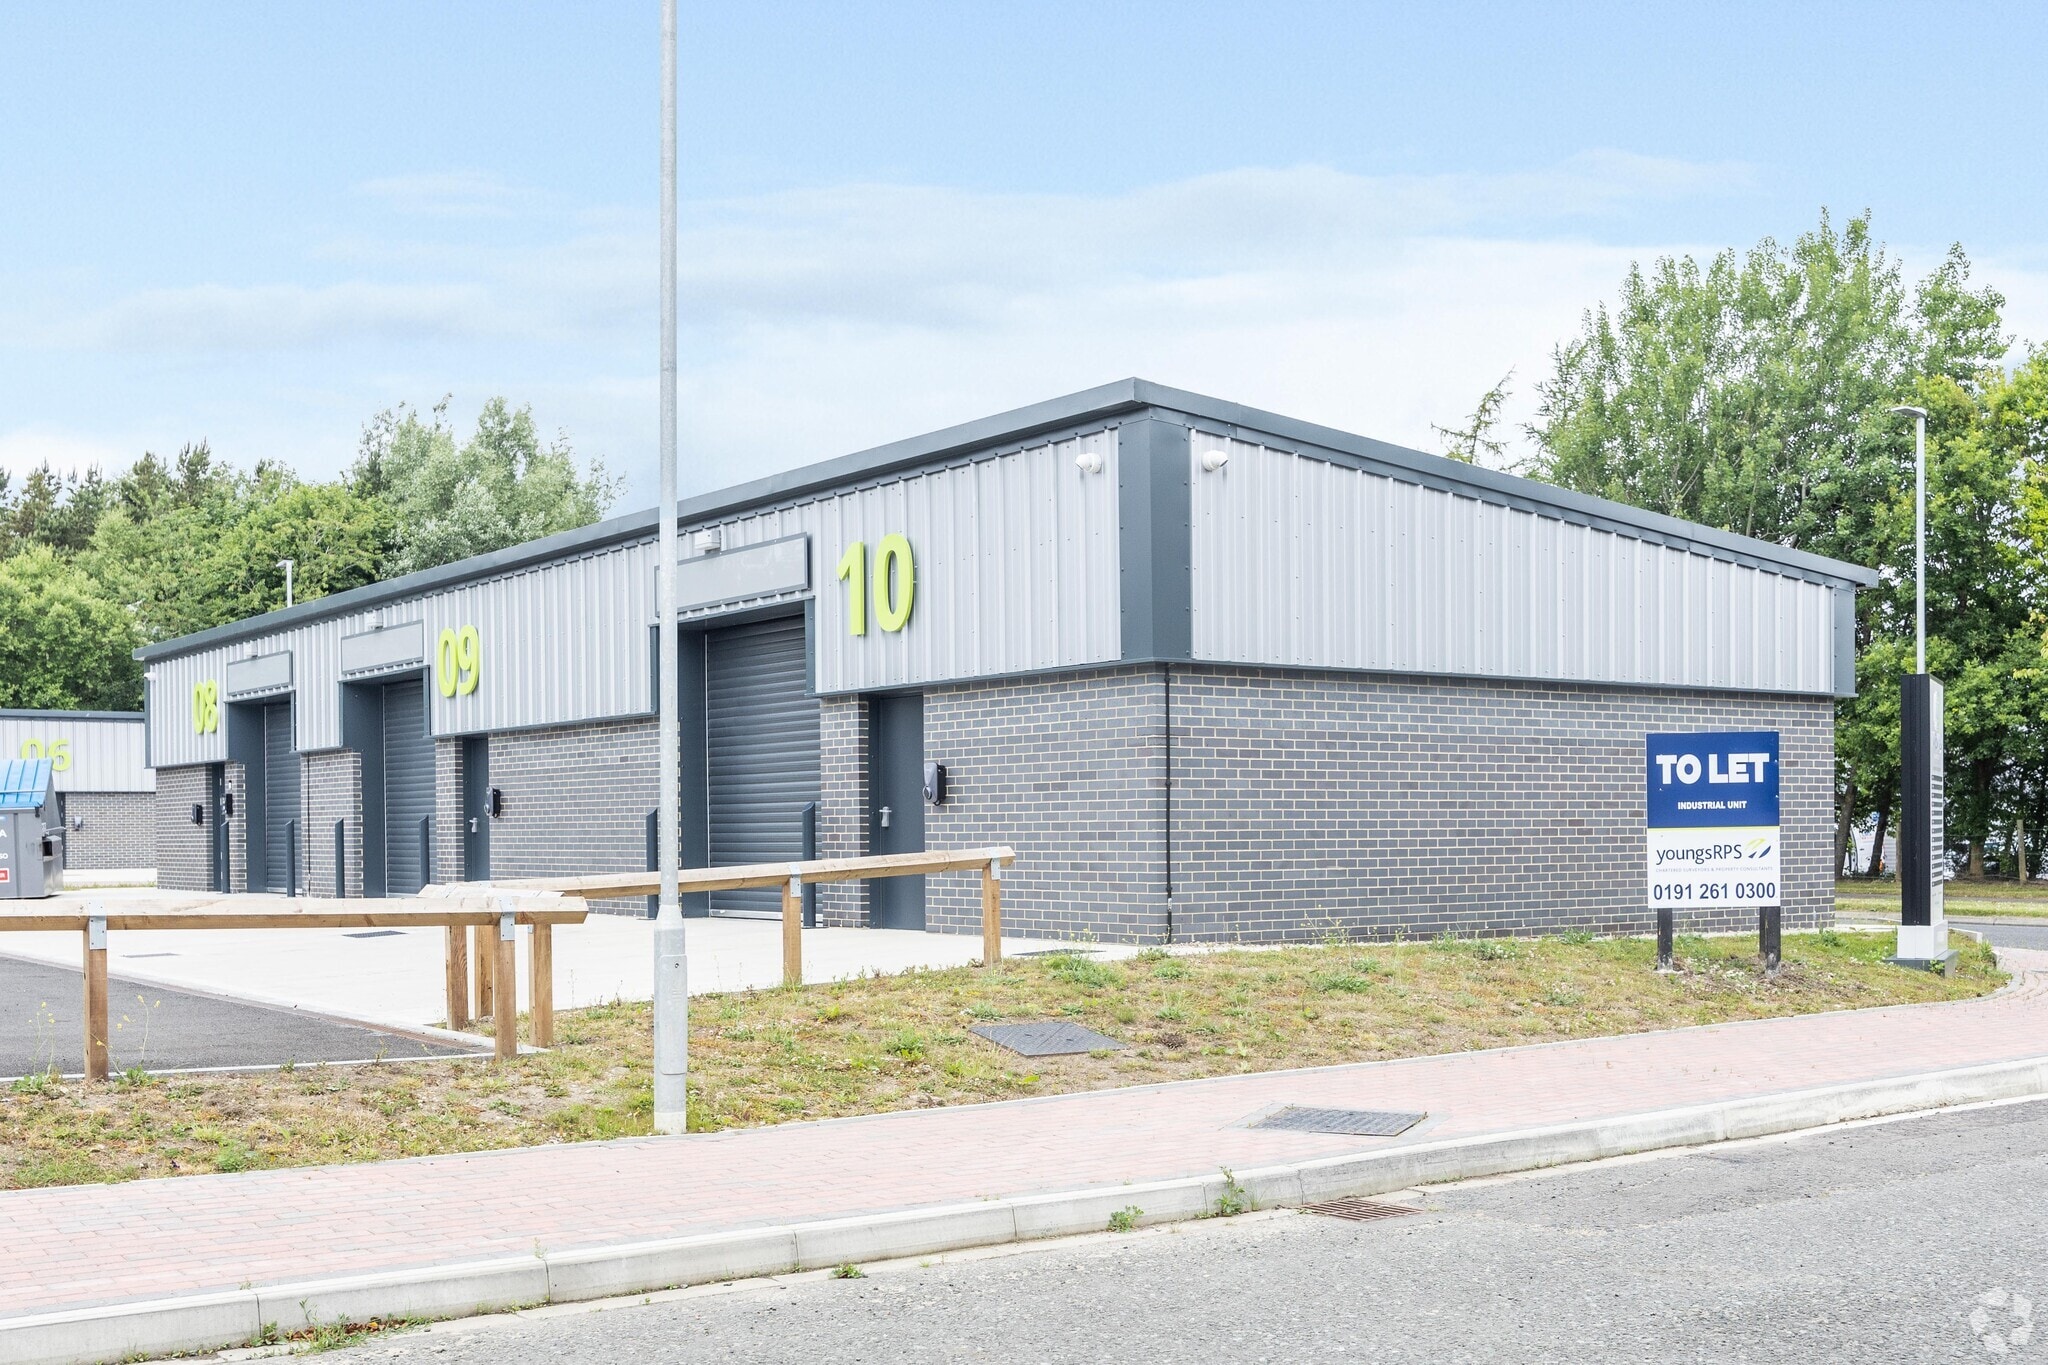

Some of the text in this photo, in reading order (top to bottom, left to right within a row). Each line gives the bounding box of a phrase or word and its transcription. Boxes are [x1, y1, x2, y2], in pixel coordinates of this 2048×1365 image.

[836, 533, 914, 636] 10
[438, 624, 479, 698] 09
[193, 679, 218, 734] 08
[1655, 752, 1770, 785] TO LET
[1678, 800, 1747, 810] INDUSTRIAL UNIT
[1655, 844, 1742, 866] youngsRPS
[1653, 882, 1776, 900] 0191 261 0300
